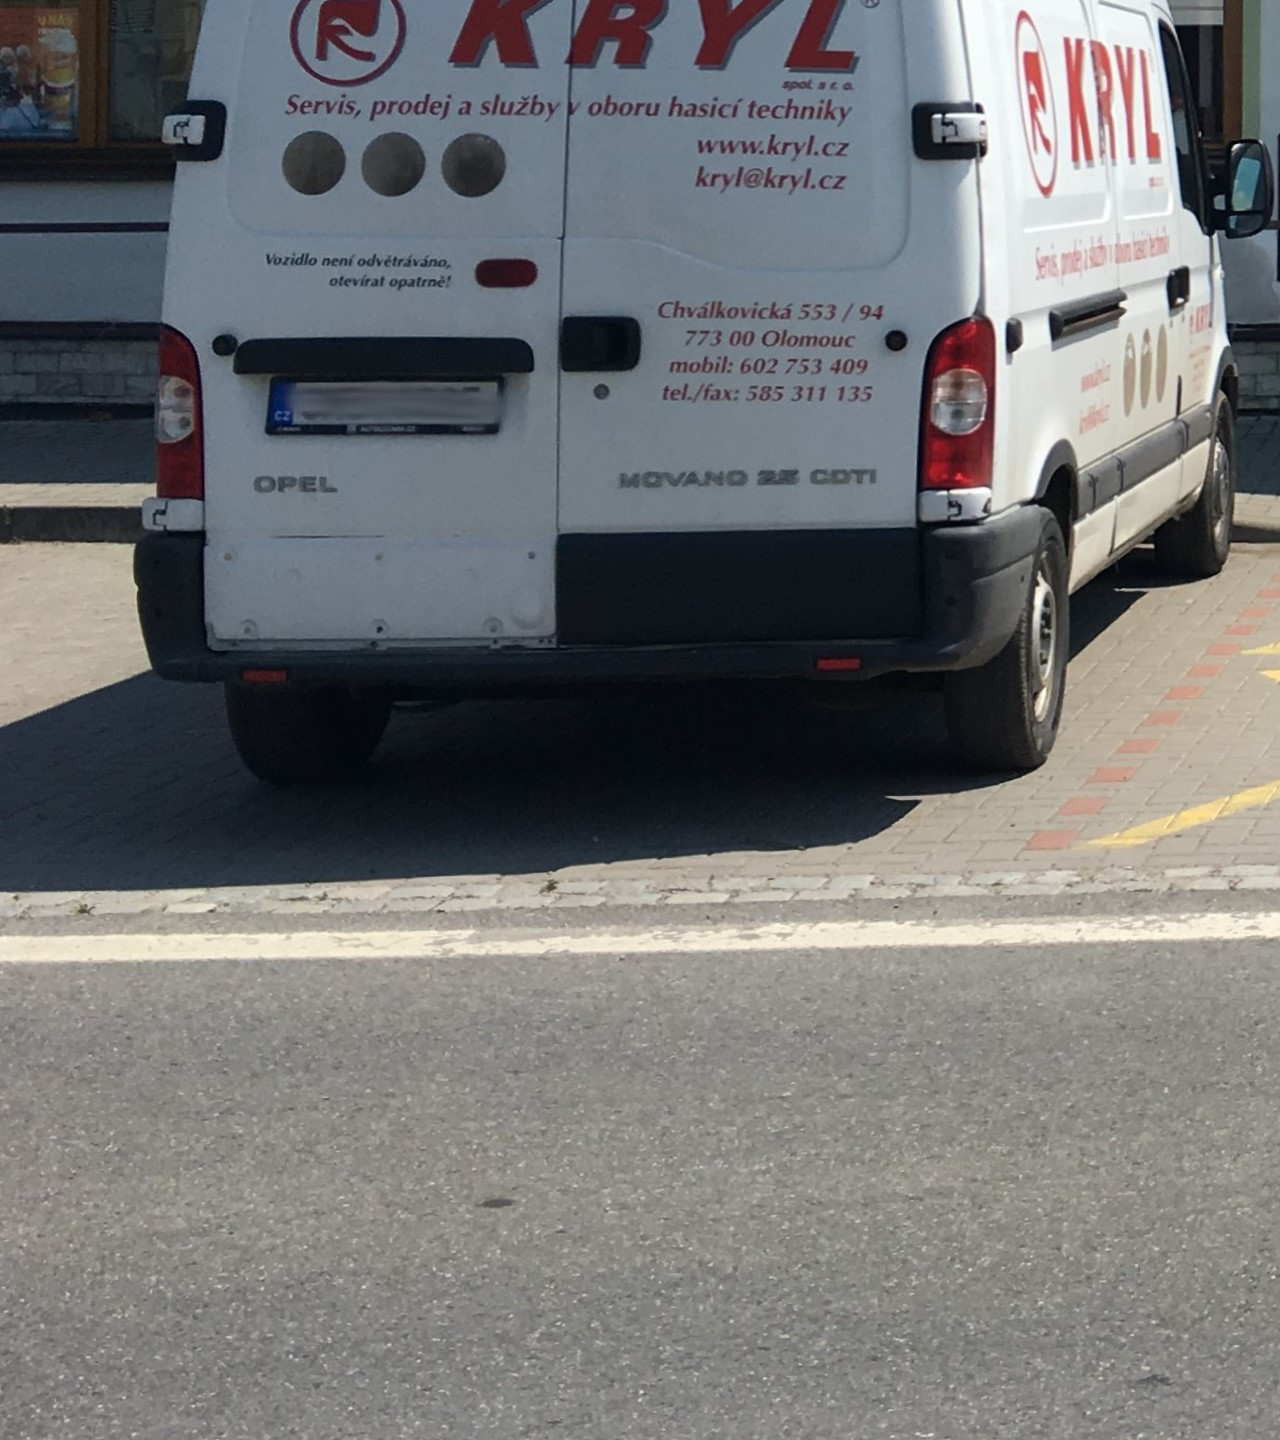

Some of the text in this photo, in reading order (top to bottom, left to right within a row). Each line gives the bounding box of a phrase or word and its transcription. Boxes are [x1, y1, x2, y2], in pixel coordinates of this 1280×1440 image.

[817, 82, 827, 90] s
[285, 93, 852, 127] Servis, prodej a služby v oboru hasicí techniky
[1063, 36, 1162, 169] KRYL
[697, 134, 850, 161] www.kryl.cz
[694, 166, 847, 194] kryl@kryl.cz
[265, 252, 453, 270] Vozidlo není odvětráváno,
[329, 273, 452, 291] otevírat opatrně!
[657, 301, 885, 323] Chválkovická 553 / 94
[684, 329, 857, 348] 773 00 Olomouc
[669, 356, 869, 376] mobil: 602 753 409
[662, 383, 873, 403] tel./fax: 585 311 135
[273, 411, 291, 421] CZ
[253, 475, 338, 493] OPEL
[618, 469, 749, 488] MOVANO
[809, 468, 878, 485] CDTI
